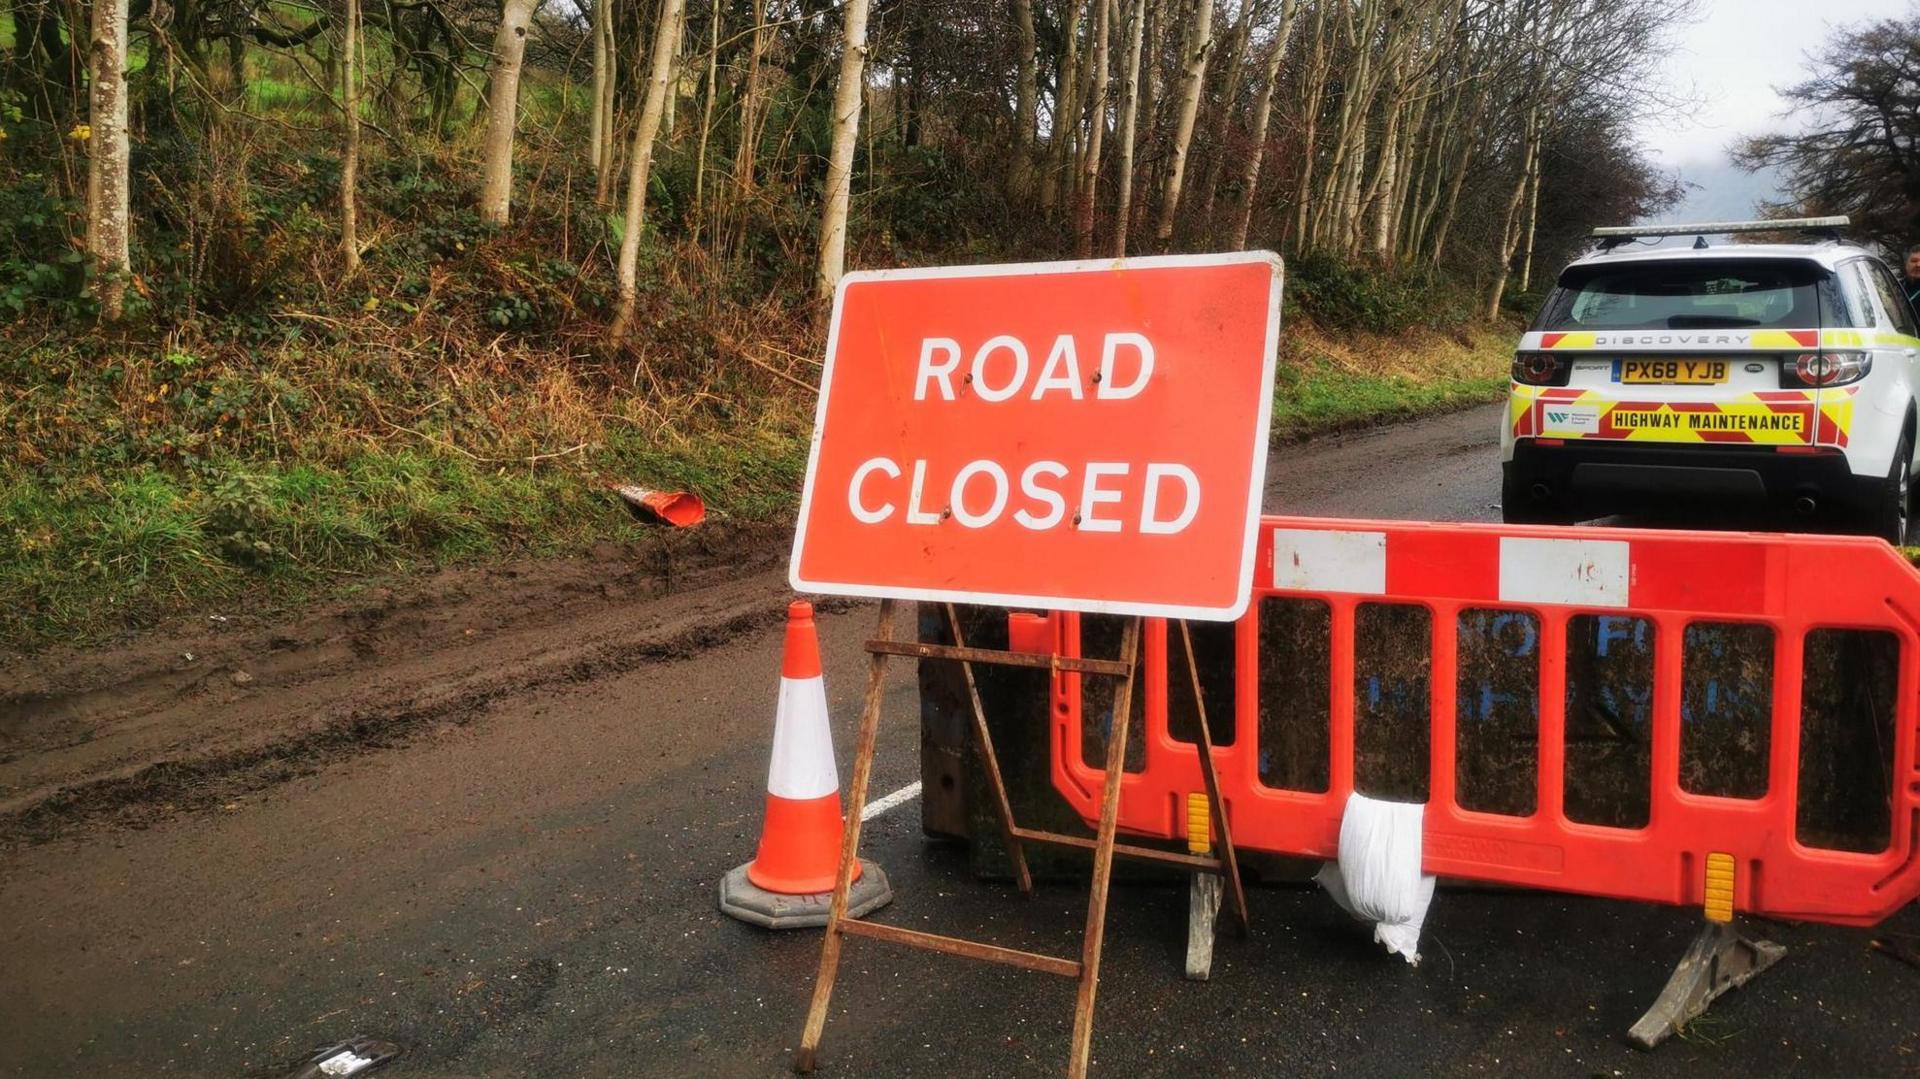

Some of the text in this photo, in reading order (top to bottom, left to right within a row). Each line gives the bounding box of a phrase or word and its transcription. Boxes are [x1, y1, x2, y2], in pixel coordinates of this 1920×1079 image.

[1594, 335, 1750, 345] DISCOVERY
[913, 332, 1156, 403] ROAD
[1624, 361, 1679, 380] PX68
[1685, 361, 1726, 380] YJB
[1614, 412, 1681, 428] HIGHWAY
[1688, 414, 1801, 431] MAINTENANCE
[847, 456, 1201, 535] CLOSED
